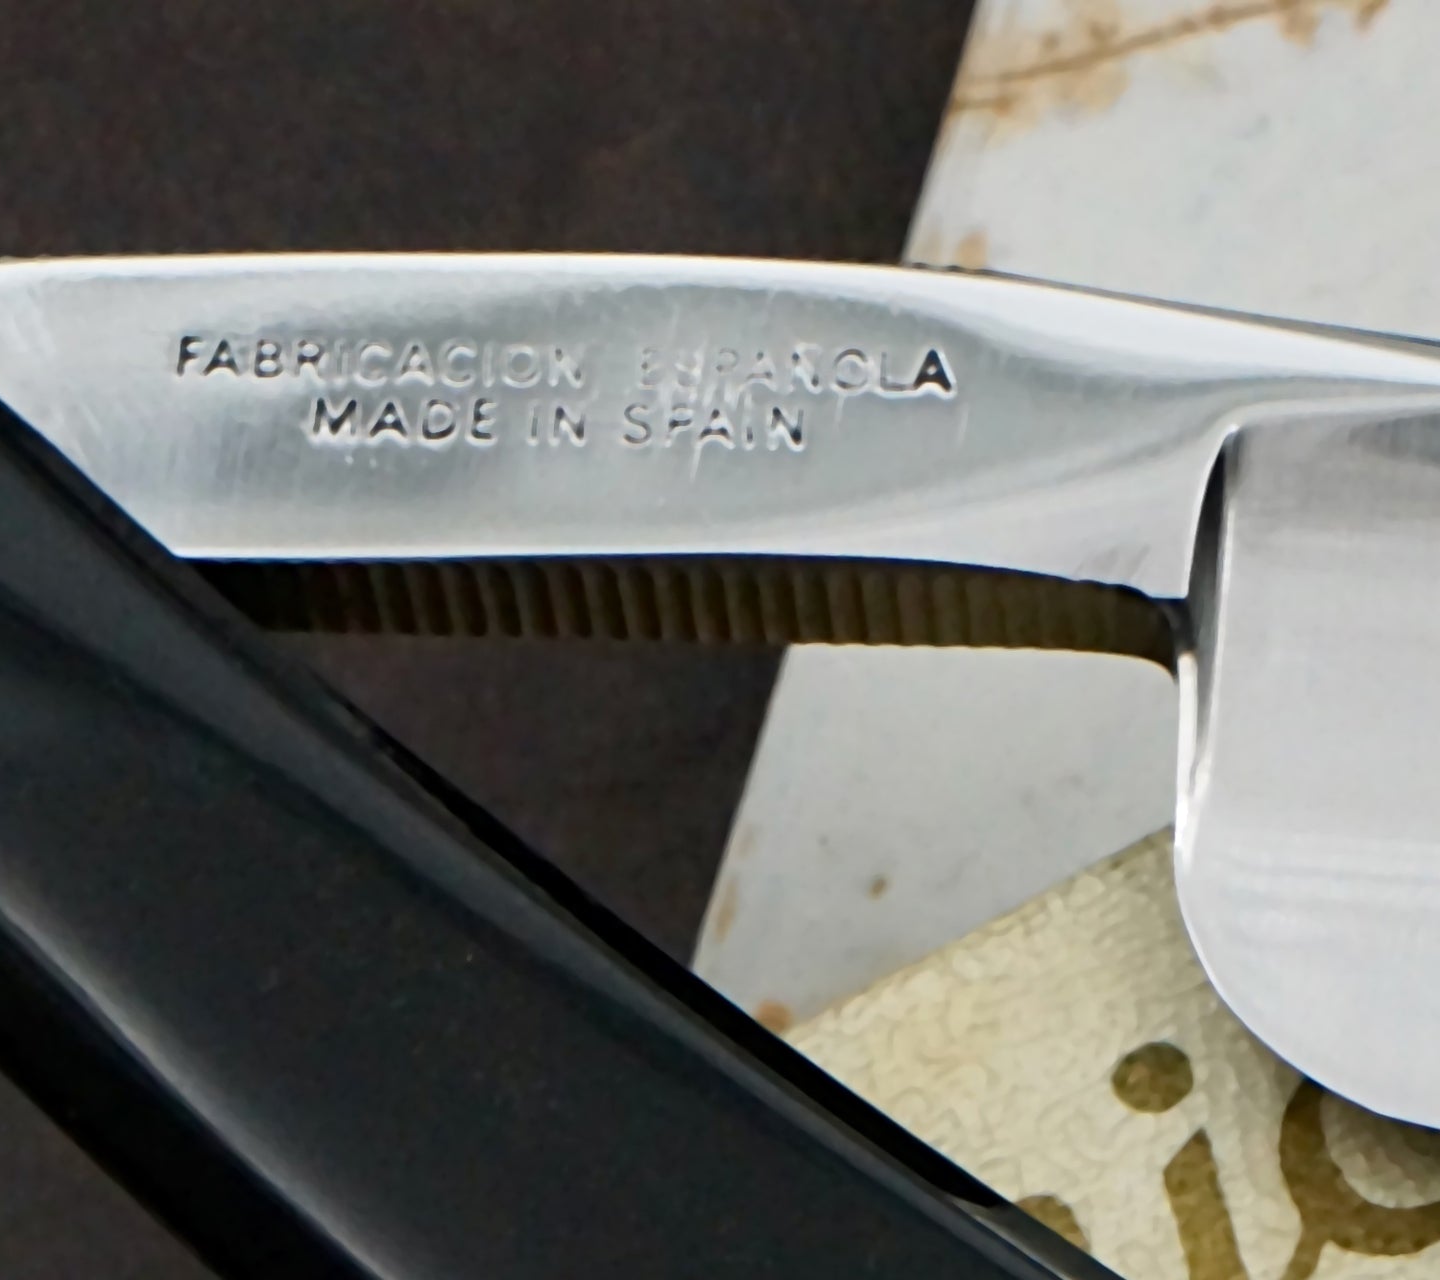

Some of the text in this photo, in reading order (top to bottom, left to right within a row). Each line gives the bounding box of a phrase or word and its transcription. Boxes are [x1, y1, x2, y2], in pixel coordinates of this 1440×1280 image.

[308, 395, 806, 452] MADE IN SPAIN
